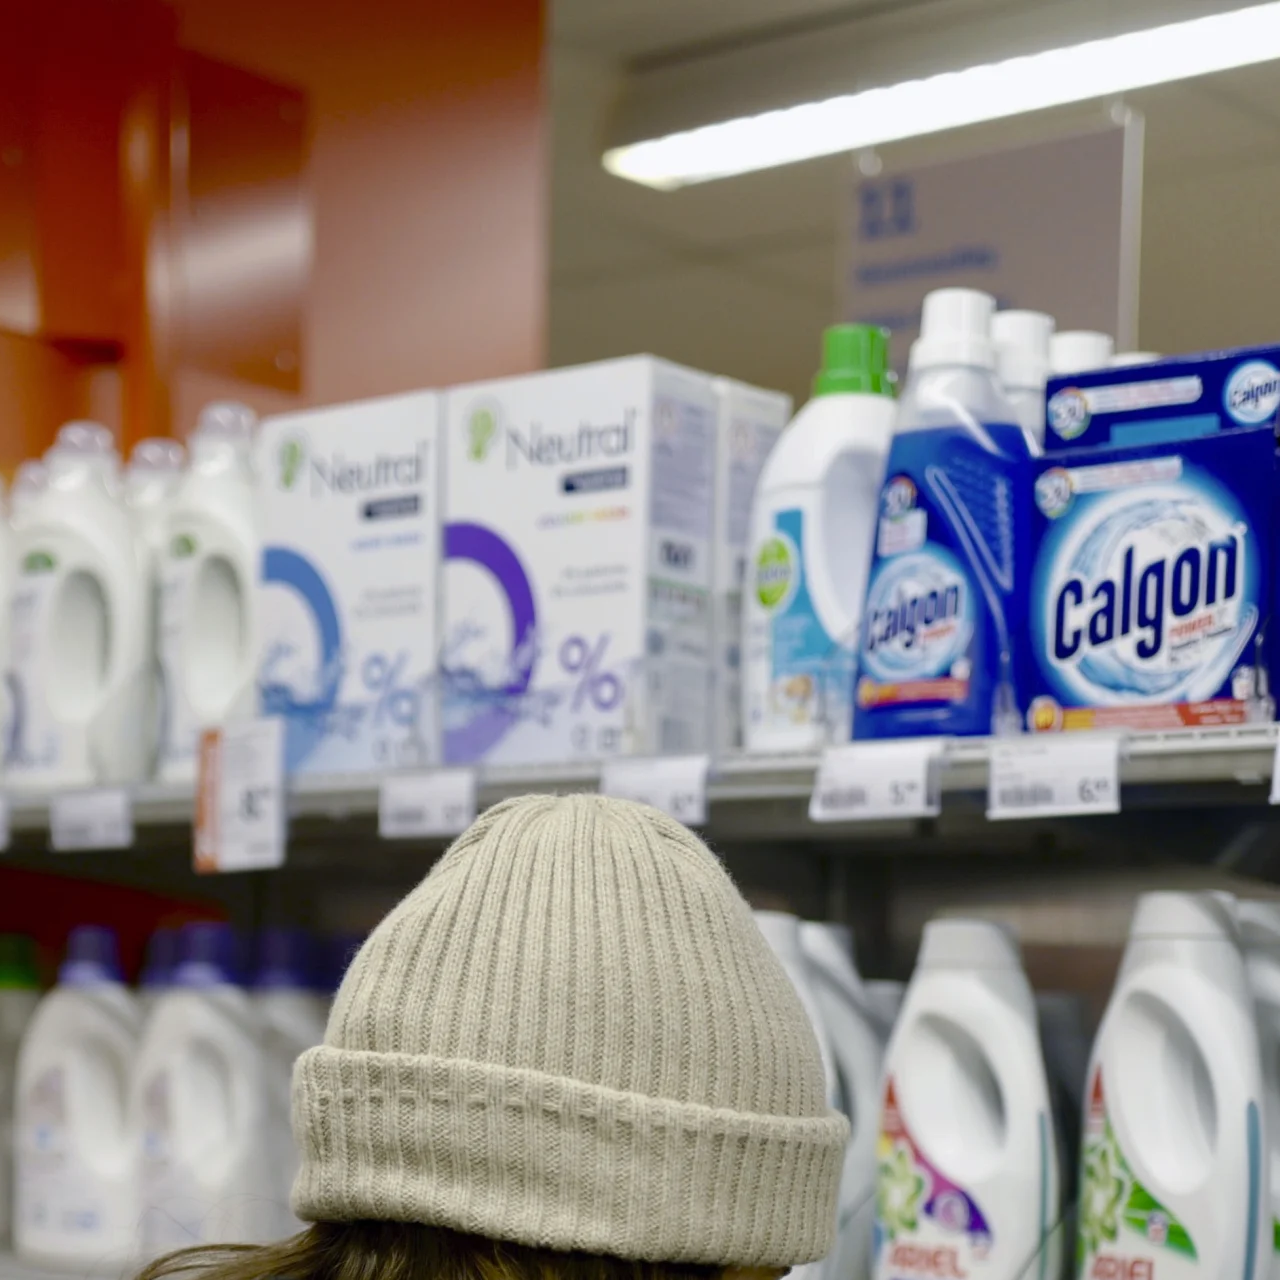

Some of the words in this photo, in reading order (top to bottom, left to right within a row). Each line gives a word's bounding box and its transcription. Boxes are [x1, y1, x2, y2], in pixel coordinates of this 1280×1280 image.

[312, 443, 426, 494] Neutral
[507, 407, 637, 470] Neutral
[868, 583, 960, 653] Calgon
[1054, 535, 1238, 663] Calgon
[888, 1238, 968, 1280] ARIEL
